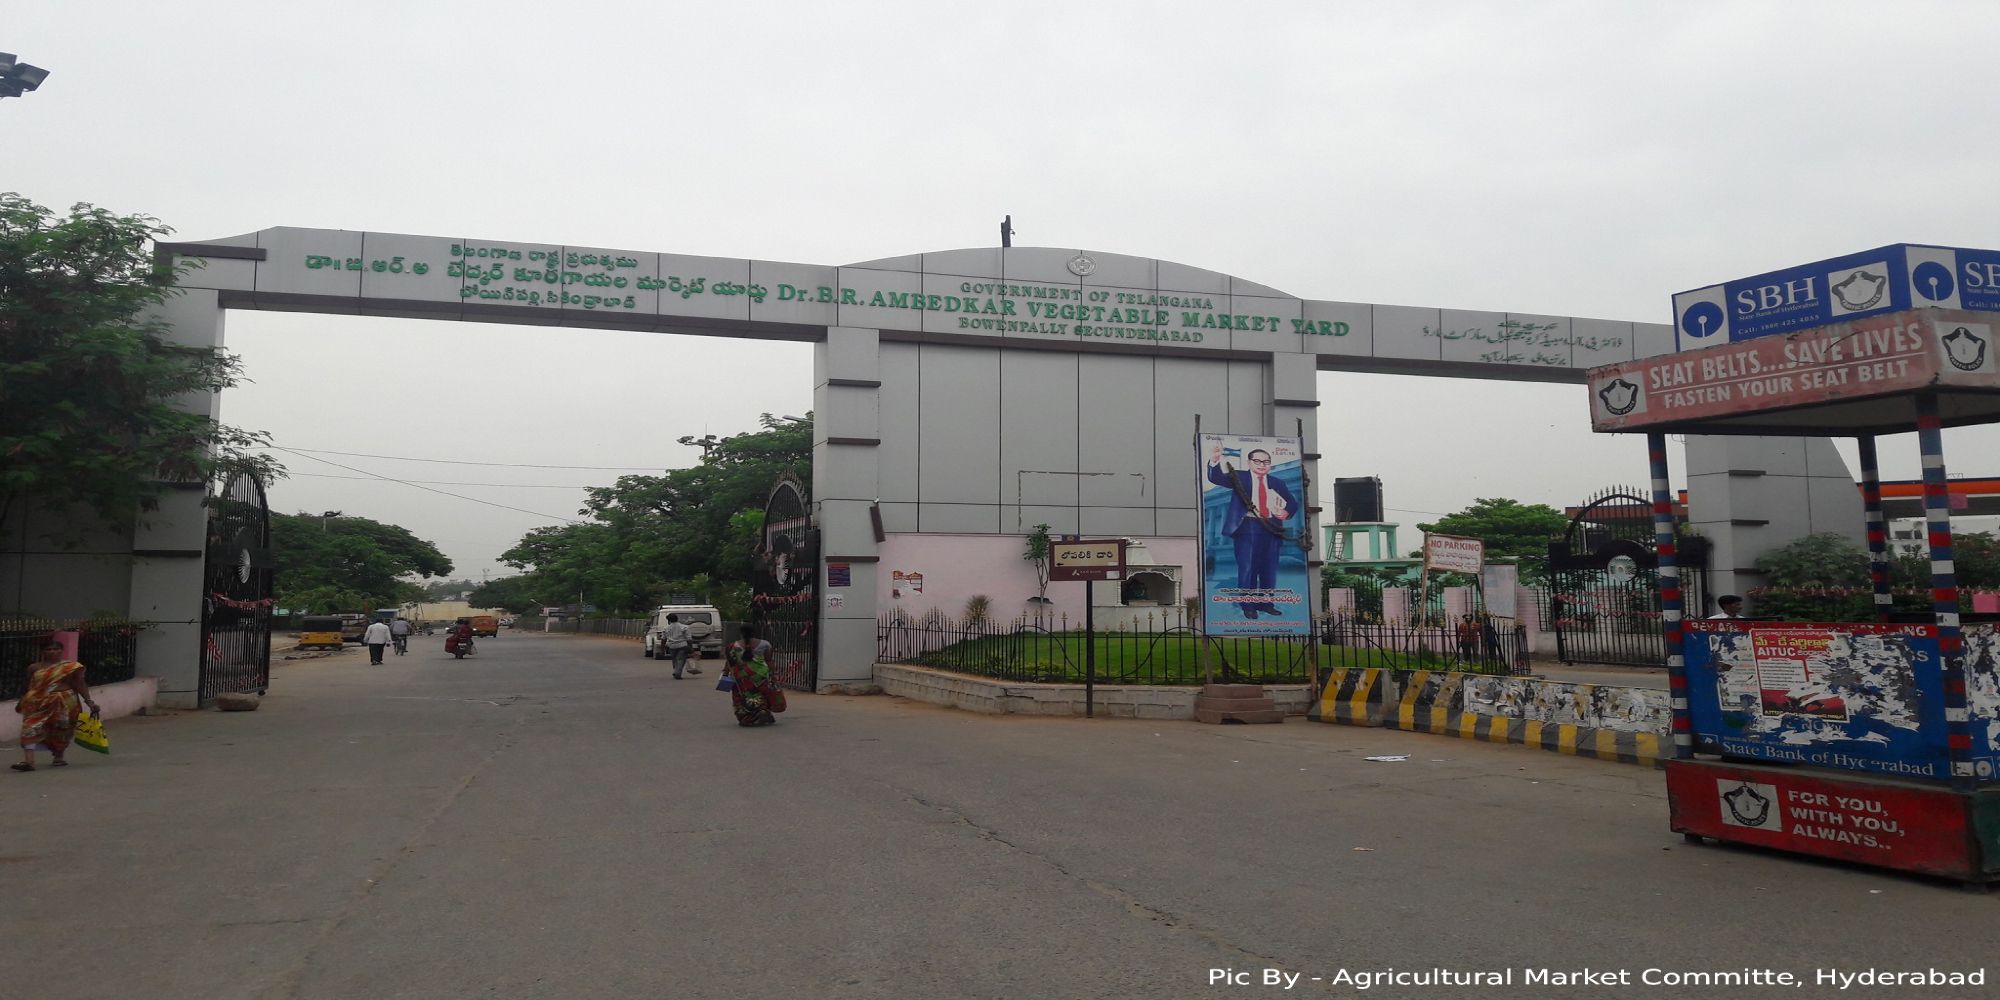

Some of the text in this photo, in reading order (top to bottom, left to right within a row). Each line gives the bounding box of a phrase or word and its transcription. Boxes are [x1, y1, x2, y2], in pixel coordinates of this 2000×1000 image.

[960, 282, 1214, 310] GOVERNMENT OF TELANGANA
[1737, 276, 1819, 315] SBH
[868, 290, 1017, 317] AMBEDKAR
[1026, 301, 1170, 326] VEGETABLE
[1181, 311, 1281, 333] MARKET
[1290, 318, 1350, 337] YARD
[958, 317, 1204, 343] BOWENPALLY SECUNDERABAD
[1737, 326, 1758, 335] Call:
[1649, 362, 1694, 389] SEAT
[1853, 322, 1923, 355] LIVES
[1664, 359, 1909, 409] FASTEN YOUR SEAT BELT
[1430, 539, 1480, 552] NO PARKING
[1757, 647, 1796, 657] AITUC
[1722, 741, 1760, 757] State
[1765, 745, 1807, 762] Bank
[1811, 752, 1831, 764] of
[1788, 789, 1889, 817] FOR YOU,
[1790, 807, 1843, 825] WITH
[1850, 815, 1905, 837] YOU,
